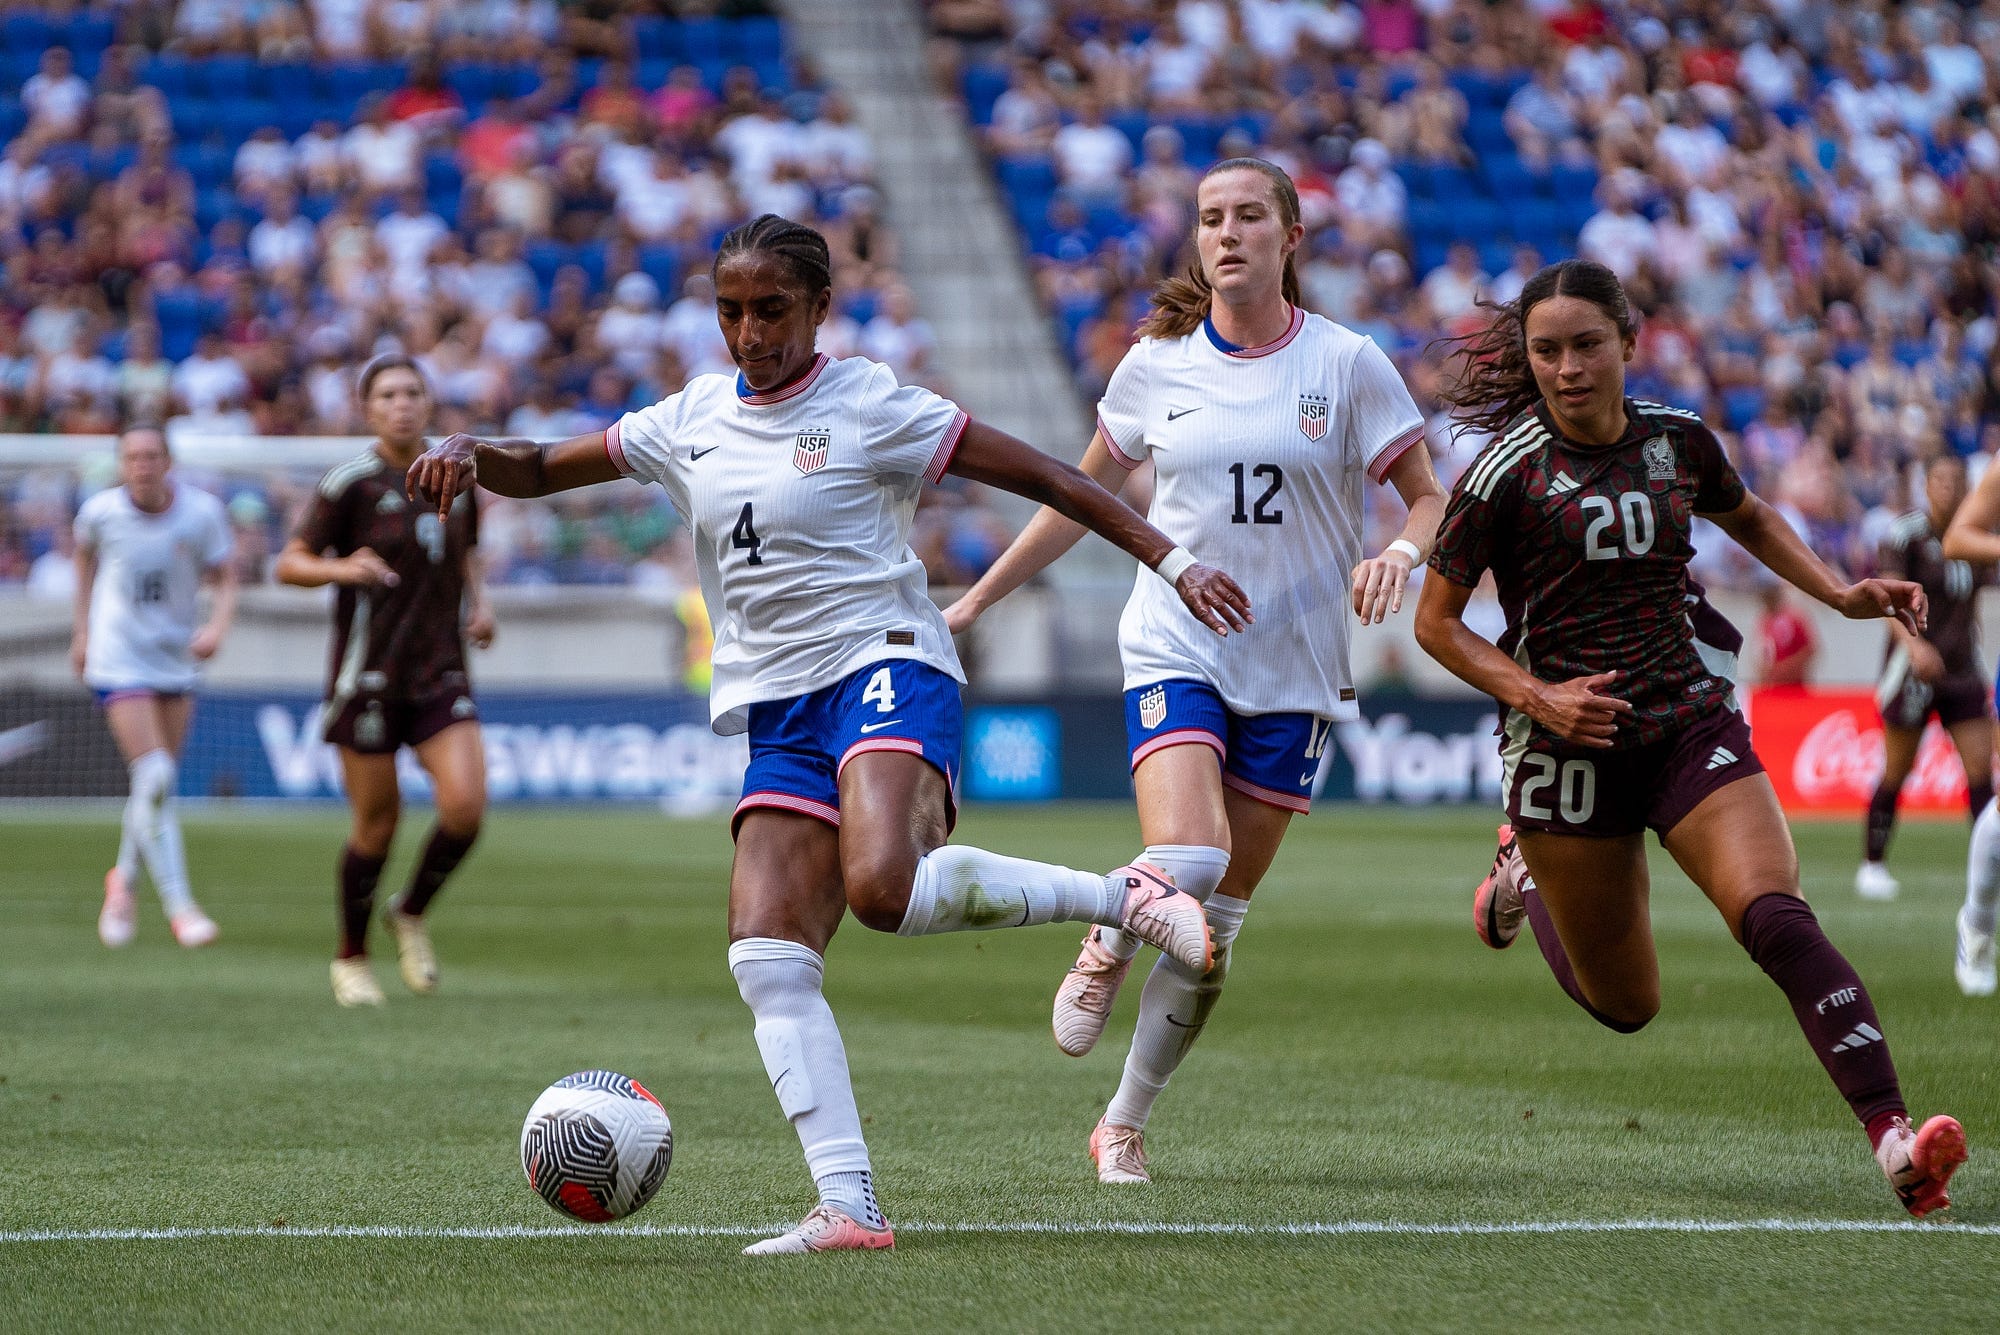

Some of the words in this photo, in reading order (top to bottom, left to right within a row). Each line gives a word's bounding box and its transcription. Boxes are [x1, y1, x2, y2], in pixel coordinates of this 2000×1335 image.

[1301, 403, 1326, 420] USA
[800, 436, 828, 452] USA
[1228, 462, 1283, 525] 12
[416, 513, 445, 563] 9
[732, 502, 763, 567] 4
[1581, 491, 1655, 561] 20
[862, 666, 895, 713] 4
[1141, 694, 1164, 711] USA
[1520, 752, 1596, 824] 20
[1817, 986, 1858, 1015] FMF
